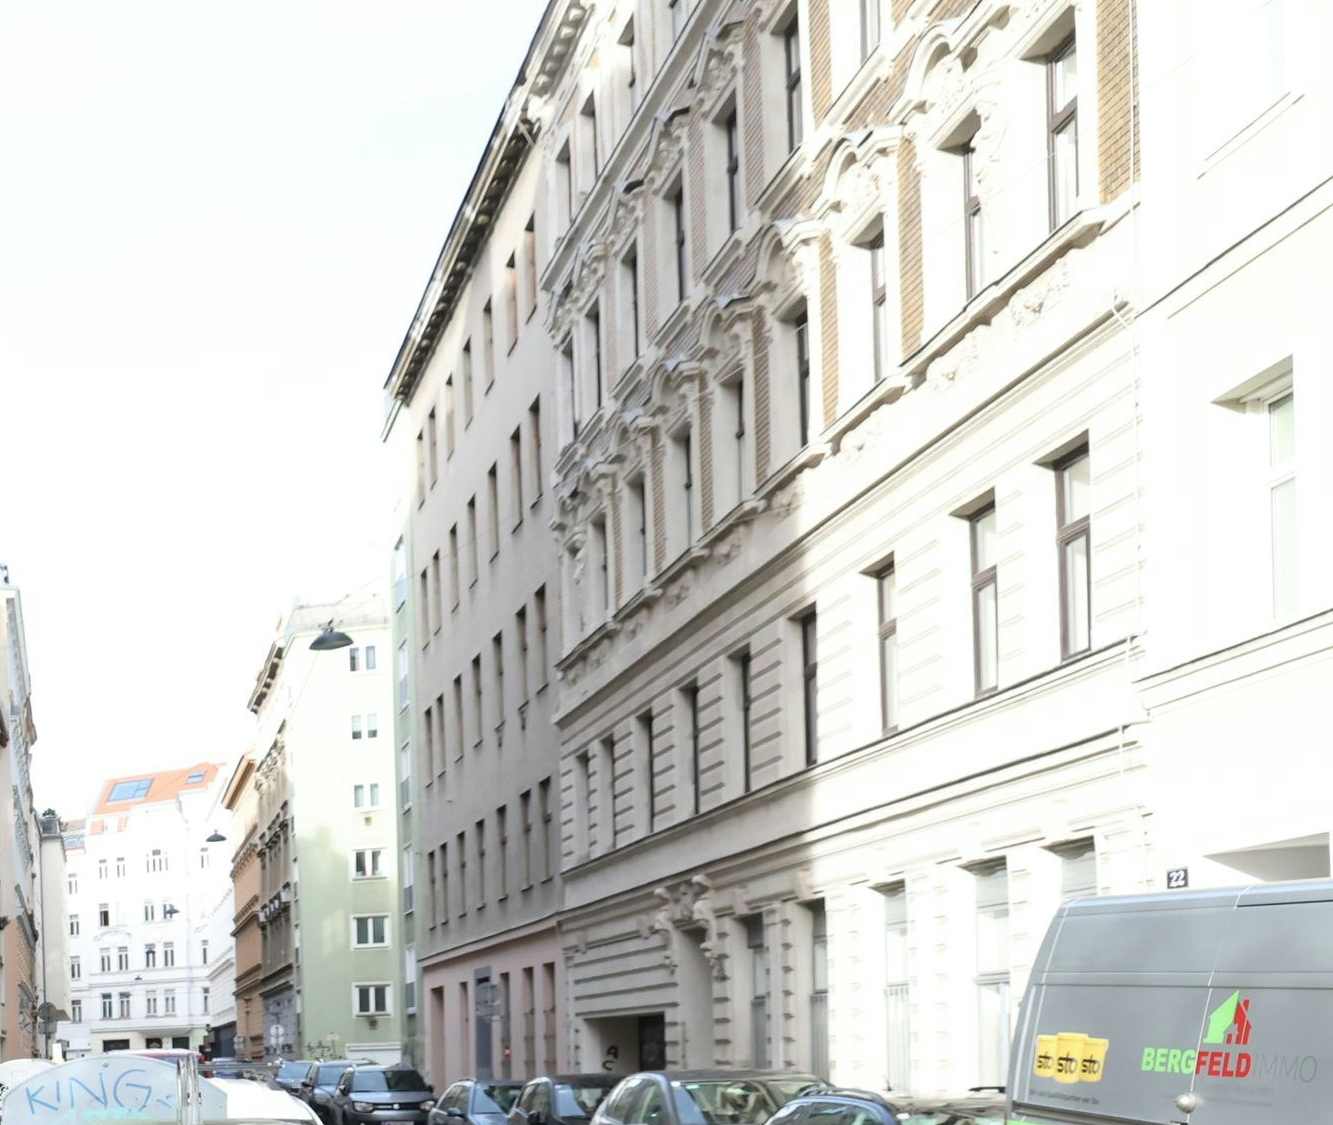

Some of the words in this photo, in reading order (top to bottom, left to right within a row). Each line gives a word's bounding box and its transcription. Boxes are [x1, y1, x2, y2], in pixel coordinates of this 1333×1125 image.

[1169, 870, 1186, 888] 22
[1057, 1052, 1078, 1074] sto
[1081, 1054, 1101, 1074] sto
